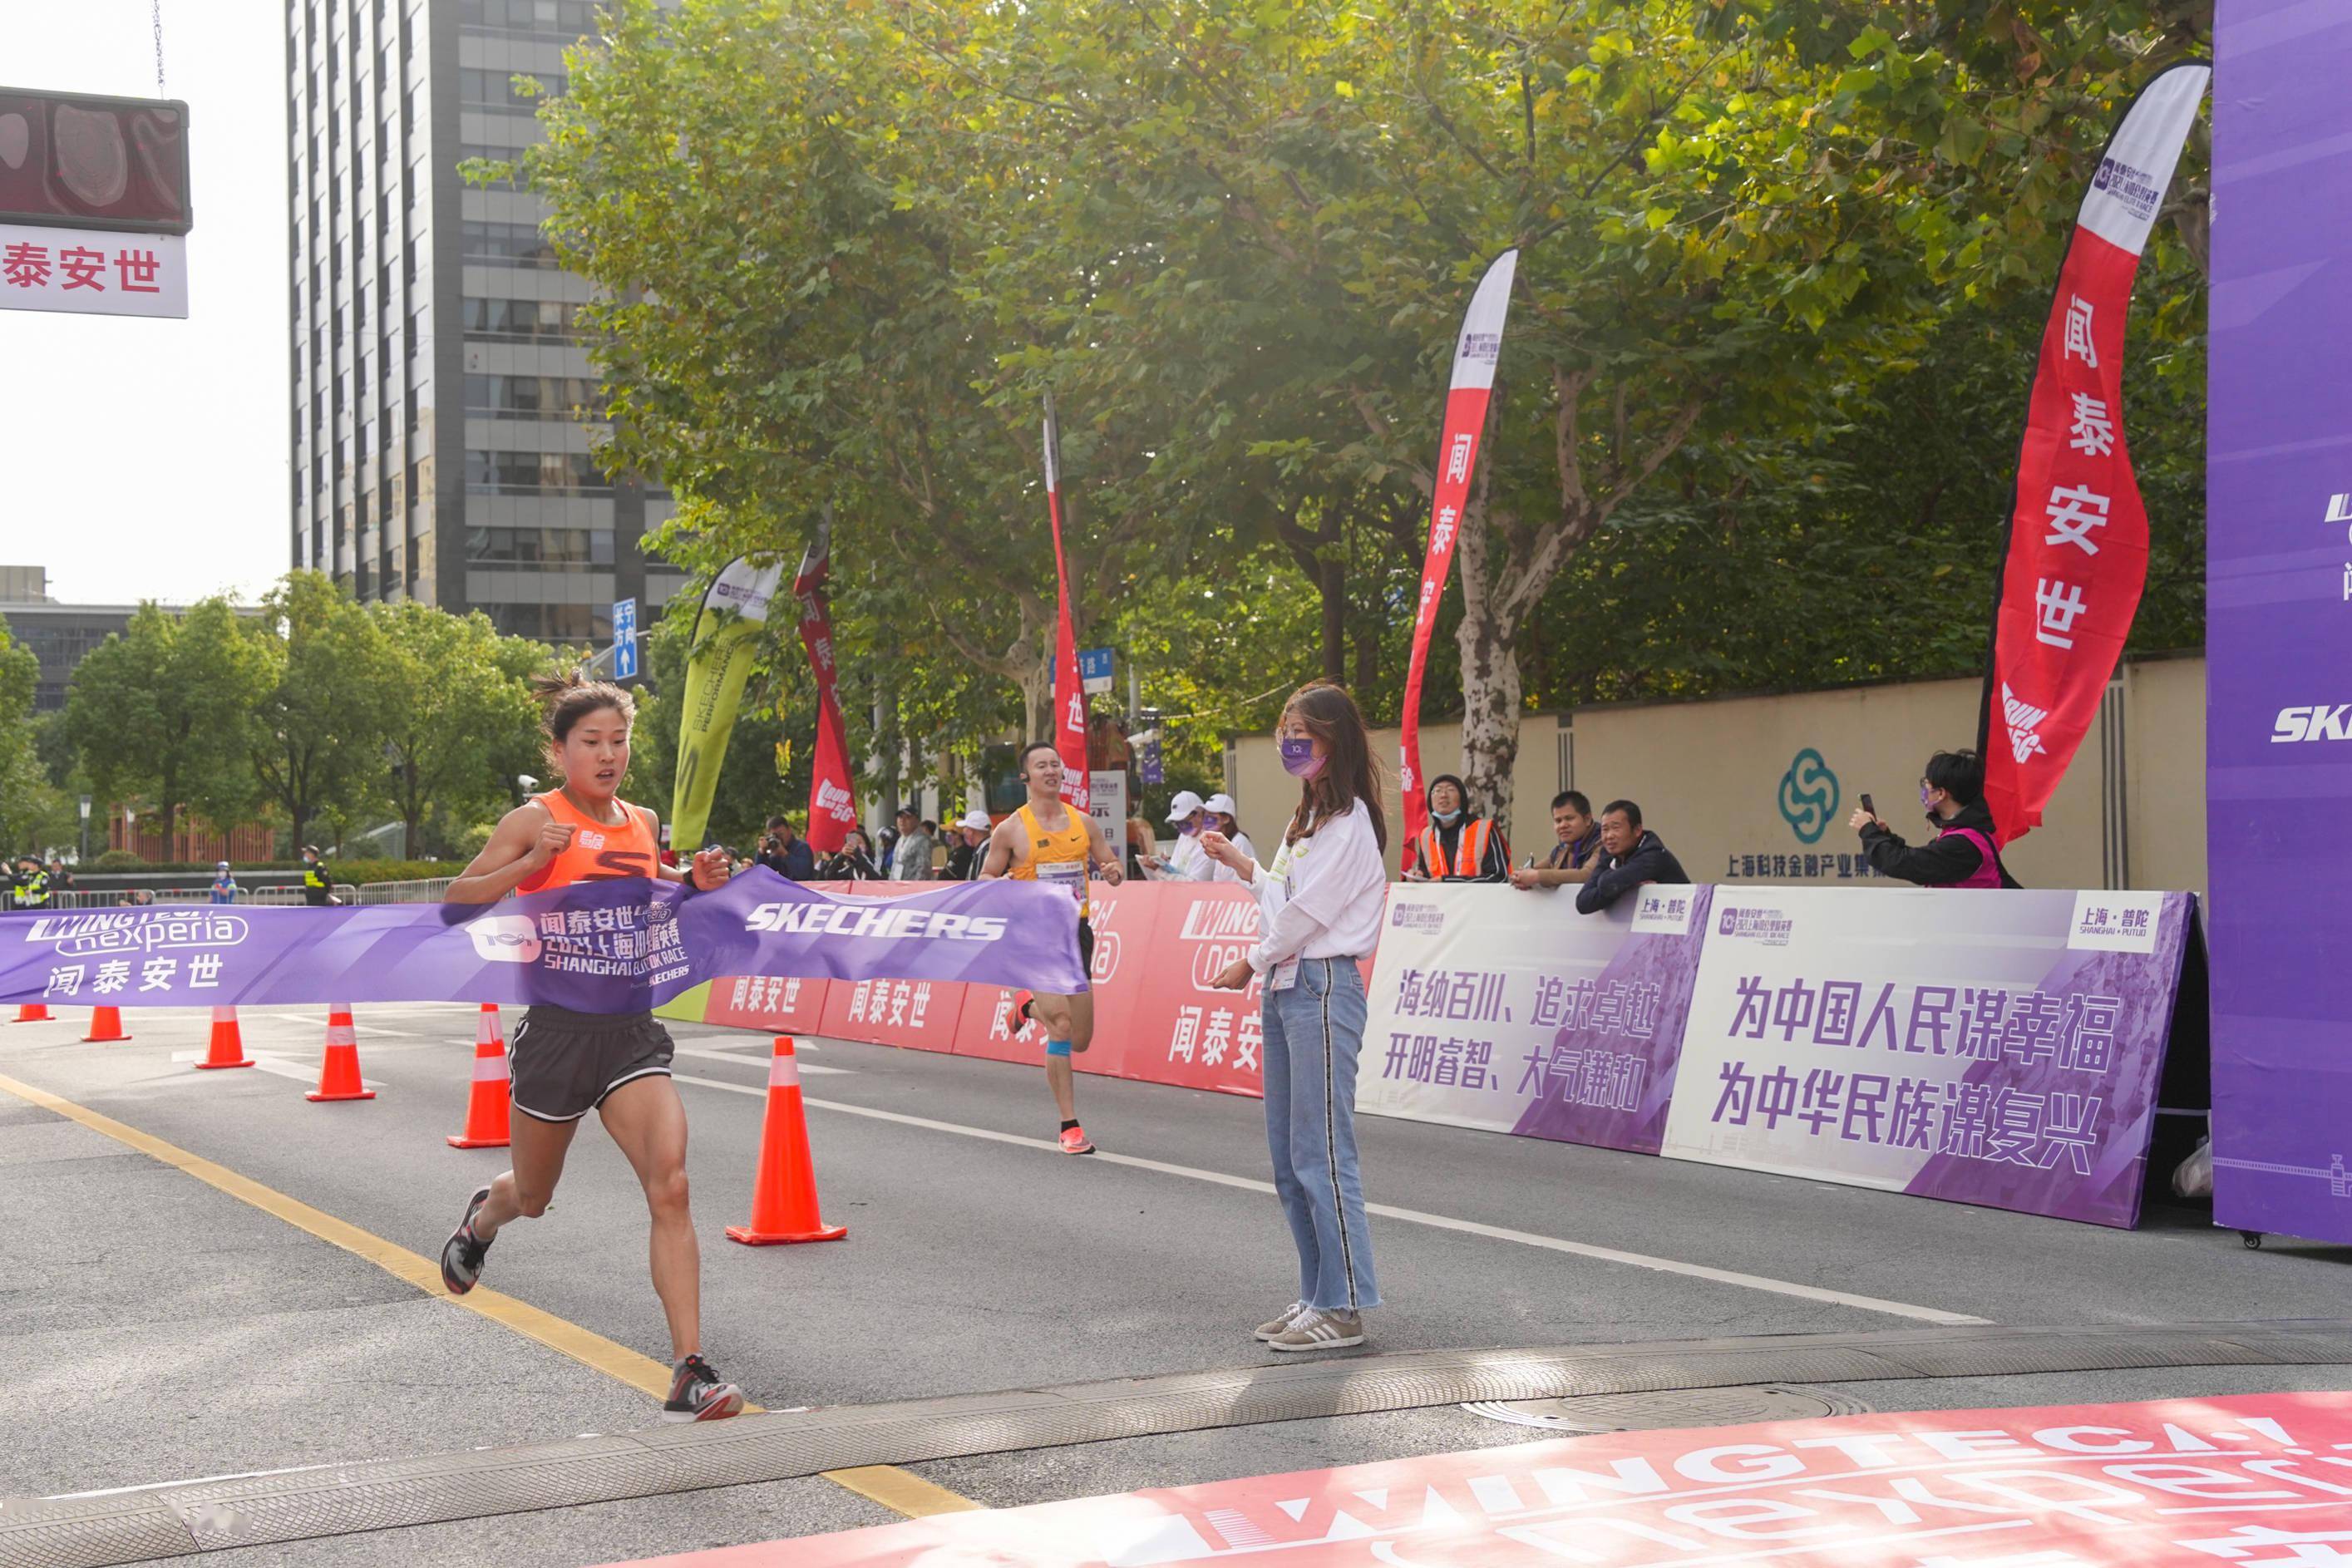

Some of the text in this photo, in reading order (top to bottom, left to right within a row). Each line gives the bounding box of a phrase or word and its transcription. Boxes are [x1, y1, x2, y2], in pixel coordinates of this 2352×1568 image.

[2, 242, 160, 293] 泰安世
[2035, 293, 2115, 650] 闻泰安世
[615, 604, 634, 625] 长宁
[615, 627, 635, 647] 方向
[2004, 698, 2048, 731] RUN
[2271, 703, 2352, 743] SK
[824, 786, 851, 804] RUN
[831, 803, 854, 822] 5G
[76, 911, 233, 953] nexperia
[540, 905, 635, 936] 闻泰安世
[745, 903, 1008, 941] SKECHERS
[2079, 925, 2147, 938] SHANGHAI PUTUO
[43, 954, 224, 998] 闻泰安世
[545, 953, 632, 977] SHANGHAI
[661, 946, 688, 967] RACE
[730, 975, 801, 1014] 闻泰安世
[848, 979, 931, 1028] 闻泰安世
[1728, 975, 2120, 1072] 为中国人民谋幸福
[1711, 1061, 2103, 1176] 为中华民族谋复兴
